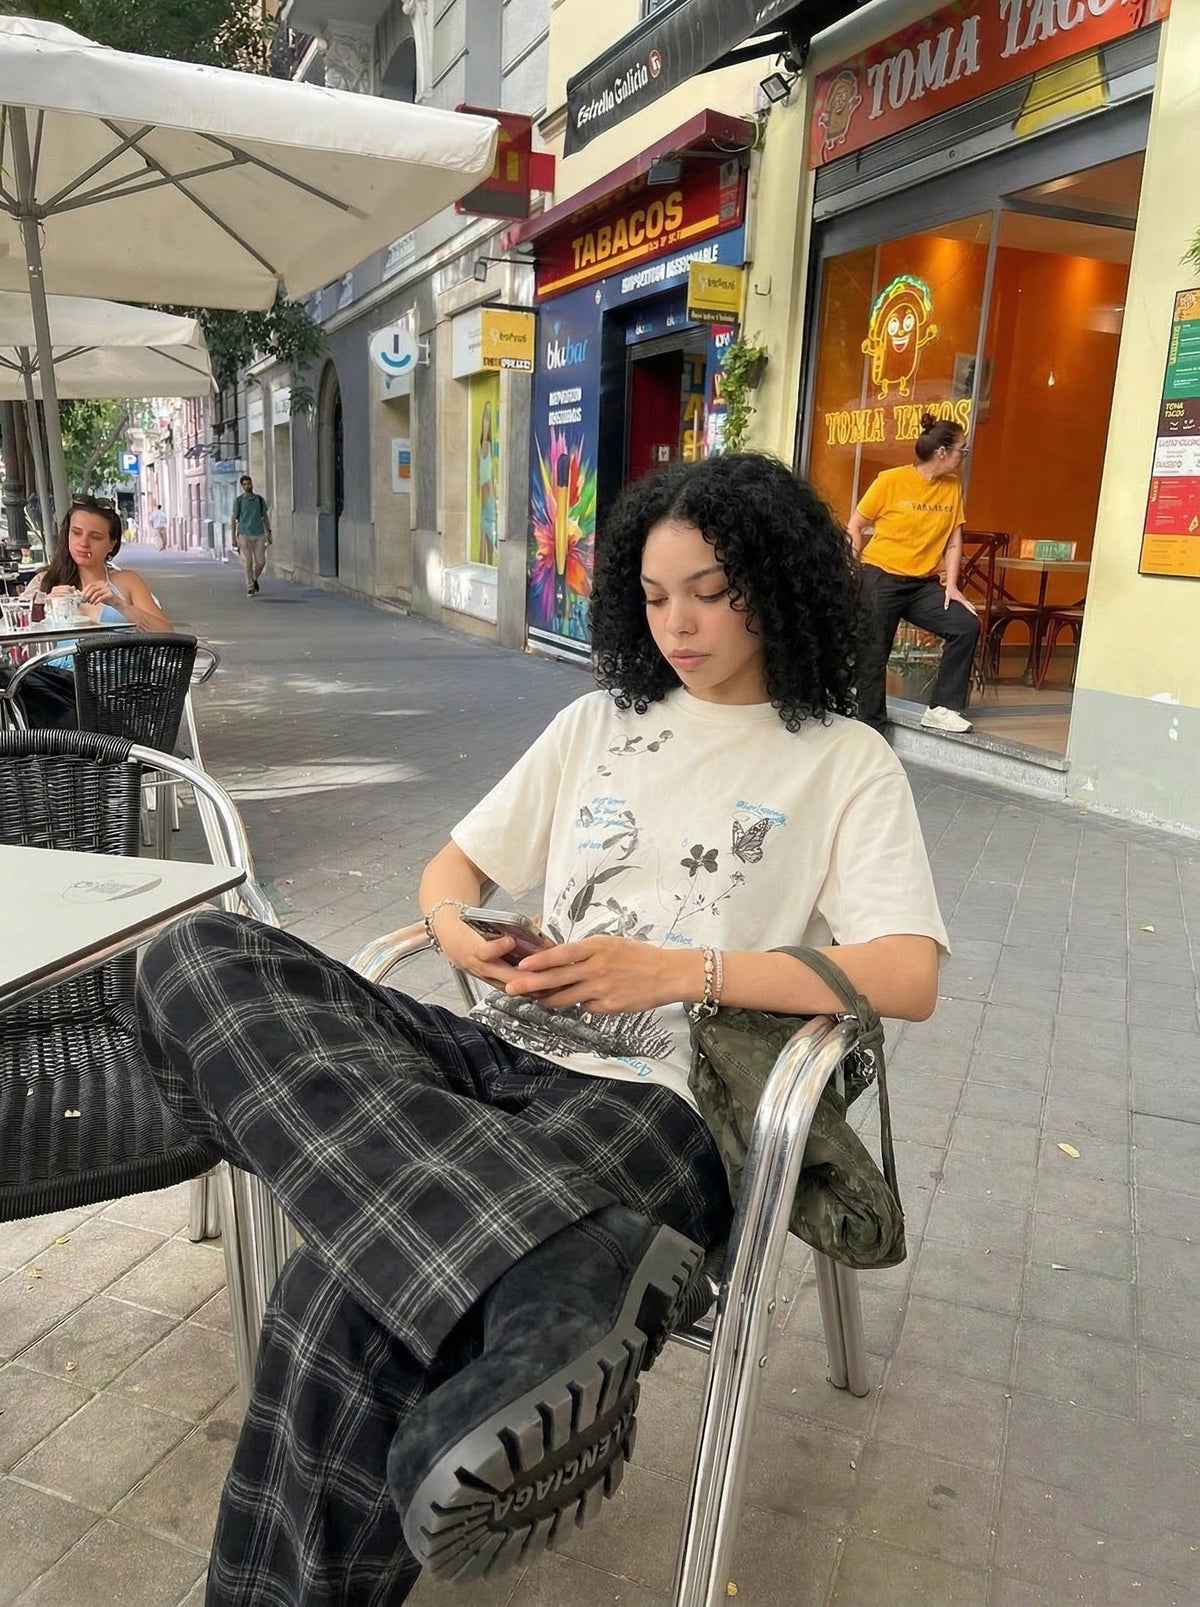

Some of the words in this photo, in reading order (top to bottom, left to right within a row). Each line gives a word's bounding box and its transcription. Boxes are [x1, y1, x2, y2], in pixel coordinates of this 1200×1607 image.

[867, 15, 980, 120] TOMA
[1000, 0, 1130, 59] TAC
[577, 89, 615, 129] Estrella
[614, 62, 649, 105] Galicia
[572, 191, 683, 270] TABACOS
[825, 408, 885, 445] TOMA
[123, 454, 137, 470] P
